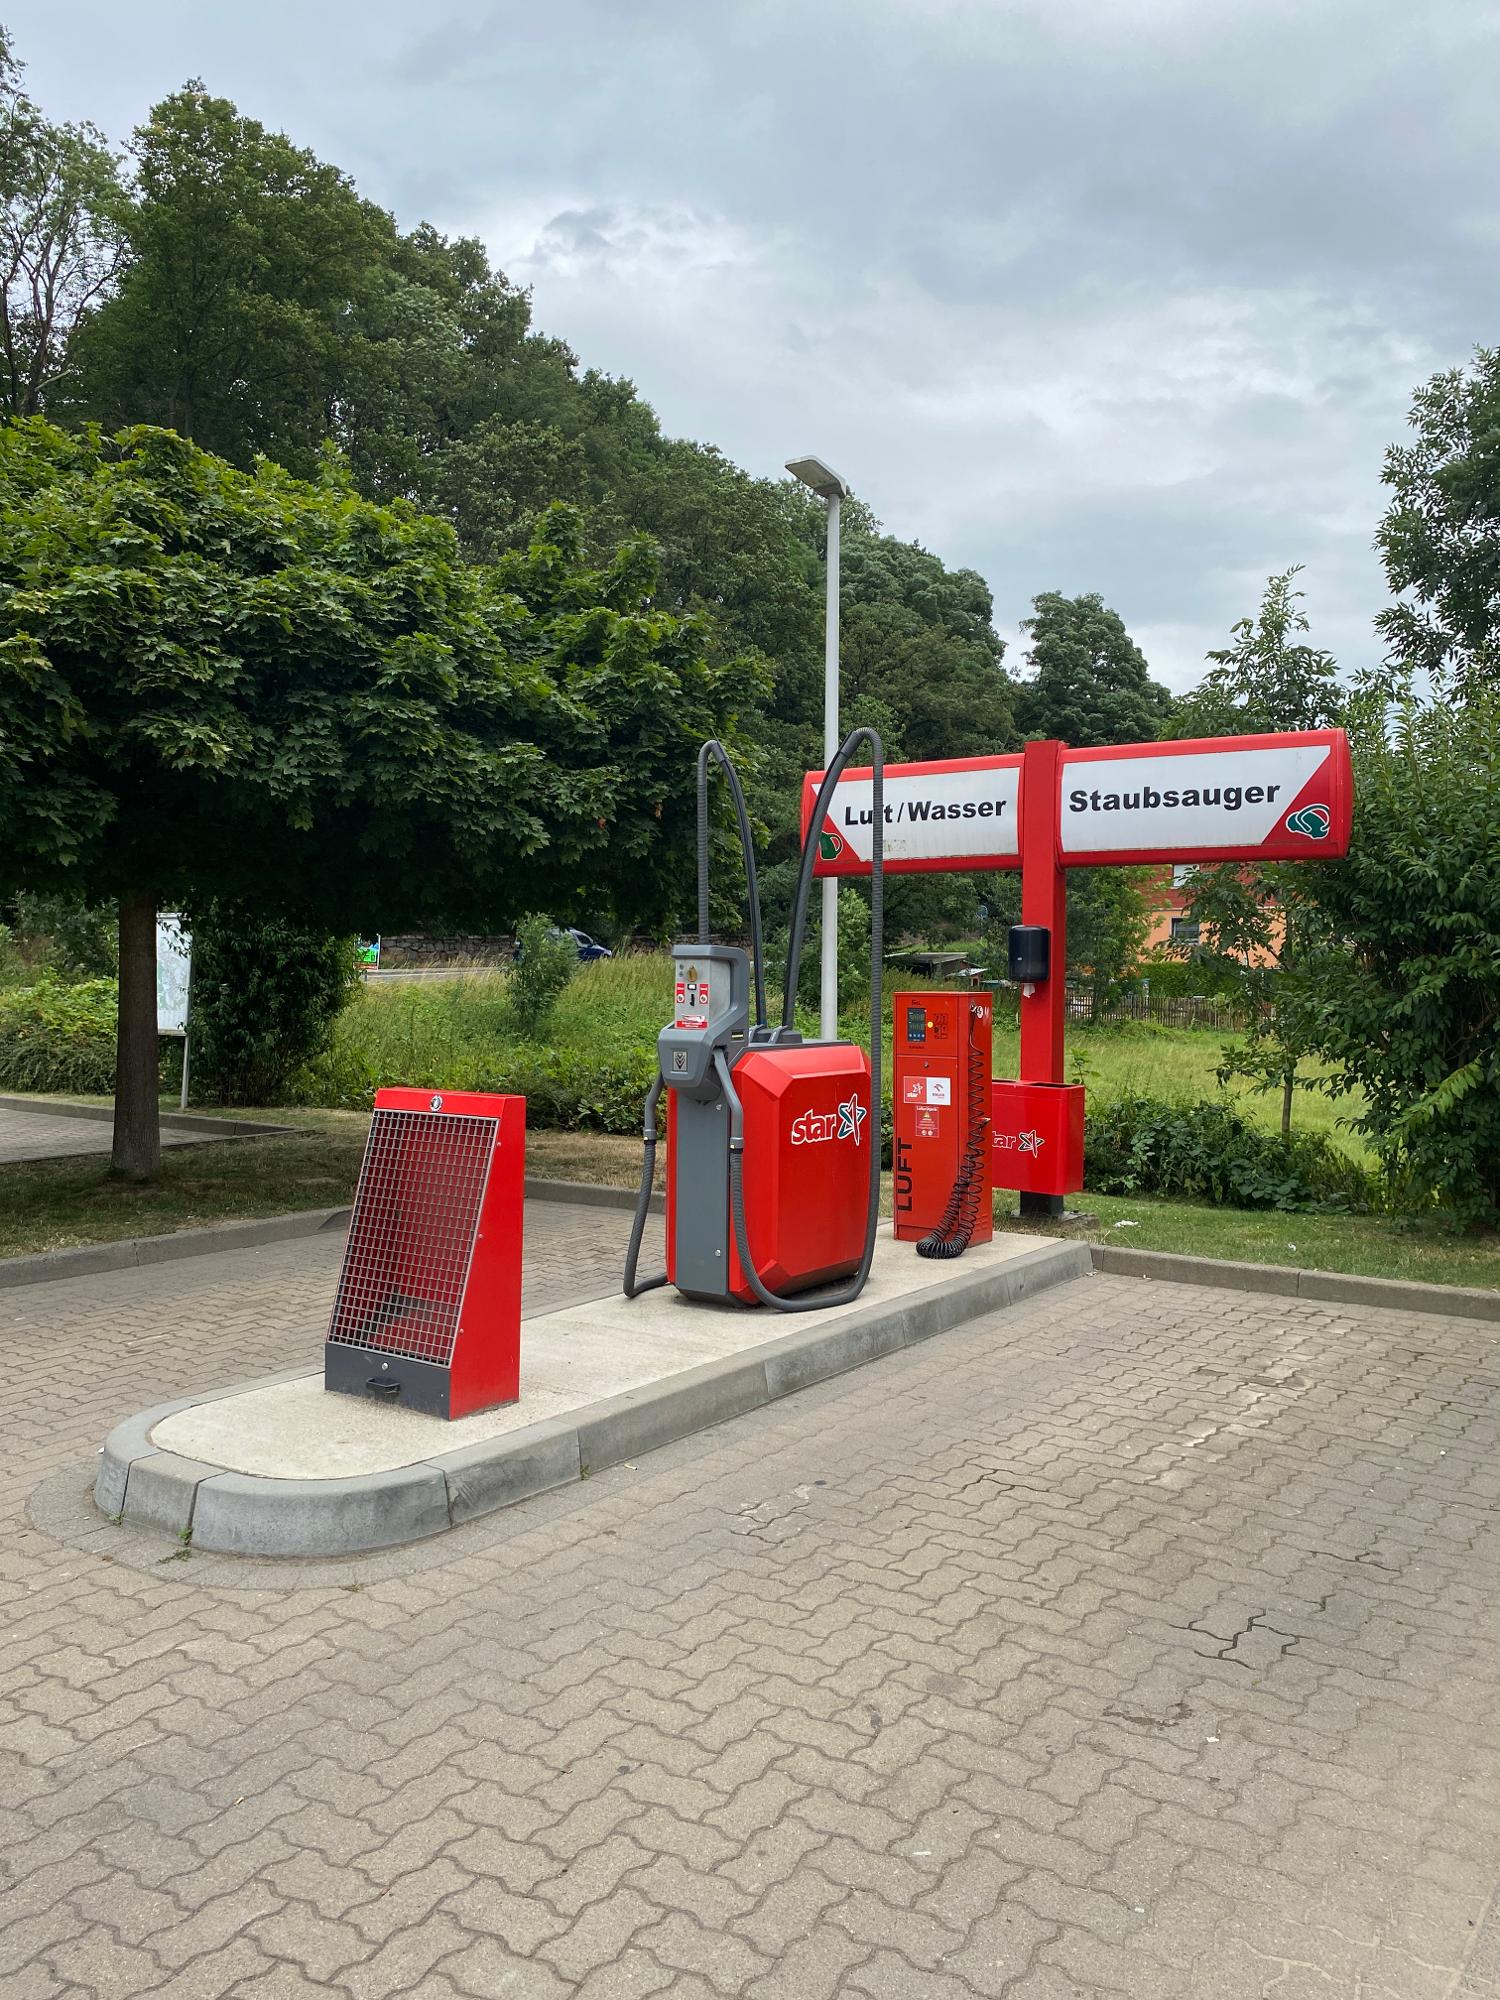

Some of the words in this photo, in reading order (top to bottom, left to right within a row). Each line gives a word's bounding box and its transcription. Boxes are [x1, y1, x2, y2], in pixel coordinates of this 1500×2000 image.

[1069, 782, 1281, 813] Staubsauger
[791, 1108, 837, 1145] star
[992, 1131, 1016, 1149] tar
[897, 1137, 912, 1212] LUFT
